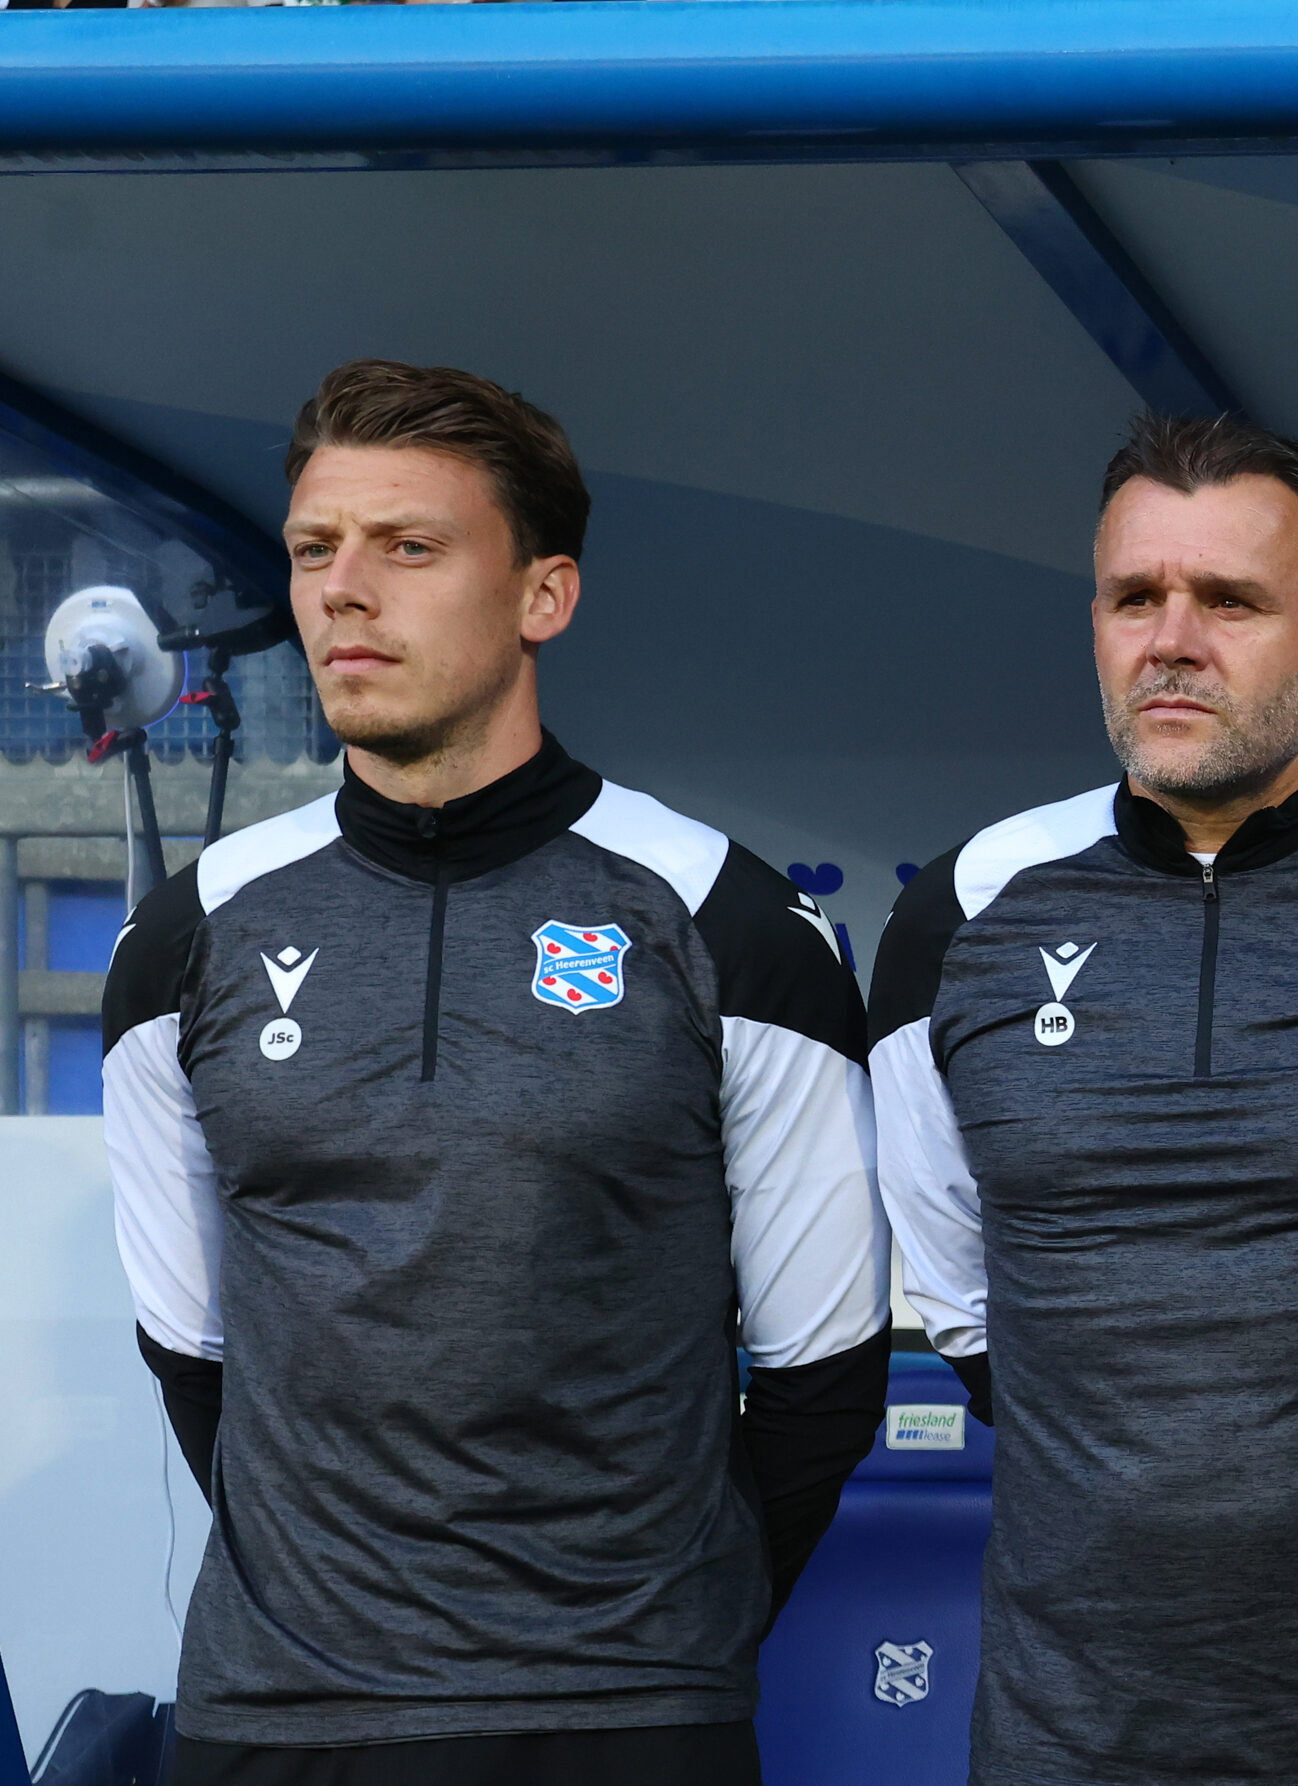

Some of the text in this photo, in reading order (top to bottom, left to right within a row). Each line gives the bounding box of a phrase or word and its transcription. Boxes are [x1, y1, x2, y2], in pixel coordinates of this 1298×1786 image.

[556, 955, 614, 970] Heerenveen
[1041, 1016, 1068, 1034] HB
[267, 1032, 294, 1045] JSc
[899, 1412, 957, 1428] friesland
[924, 1429, 951, 1441] lease
